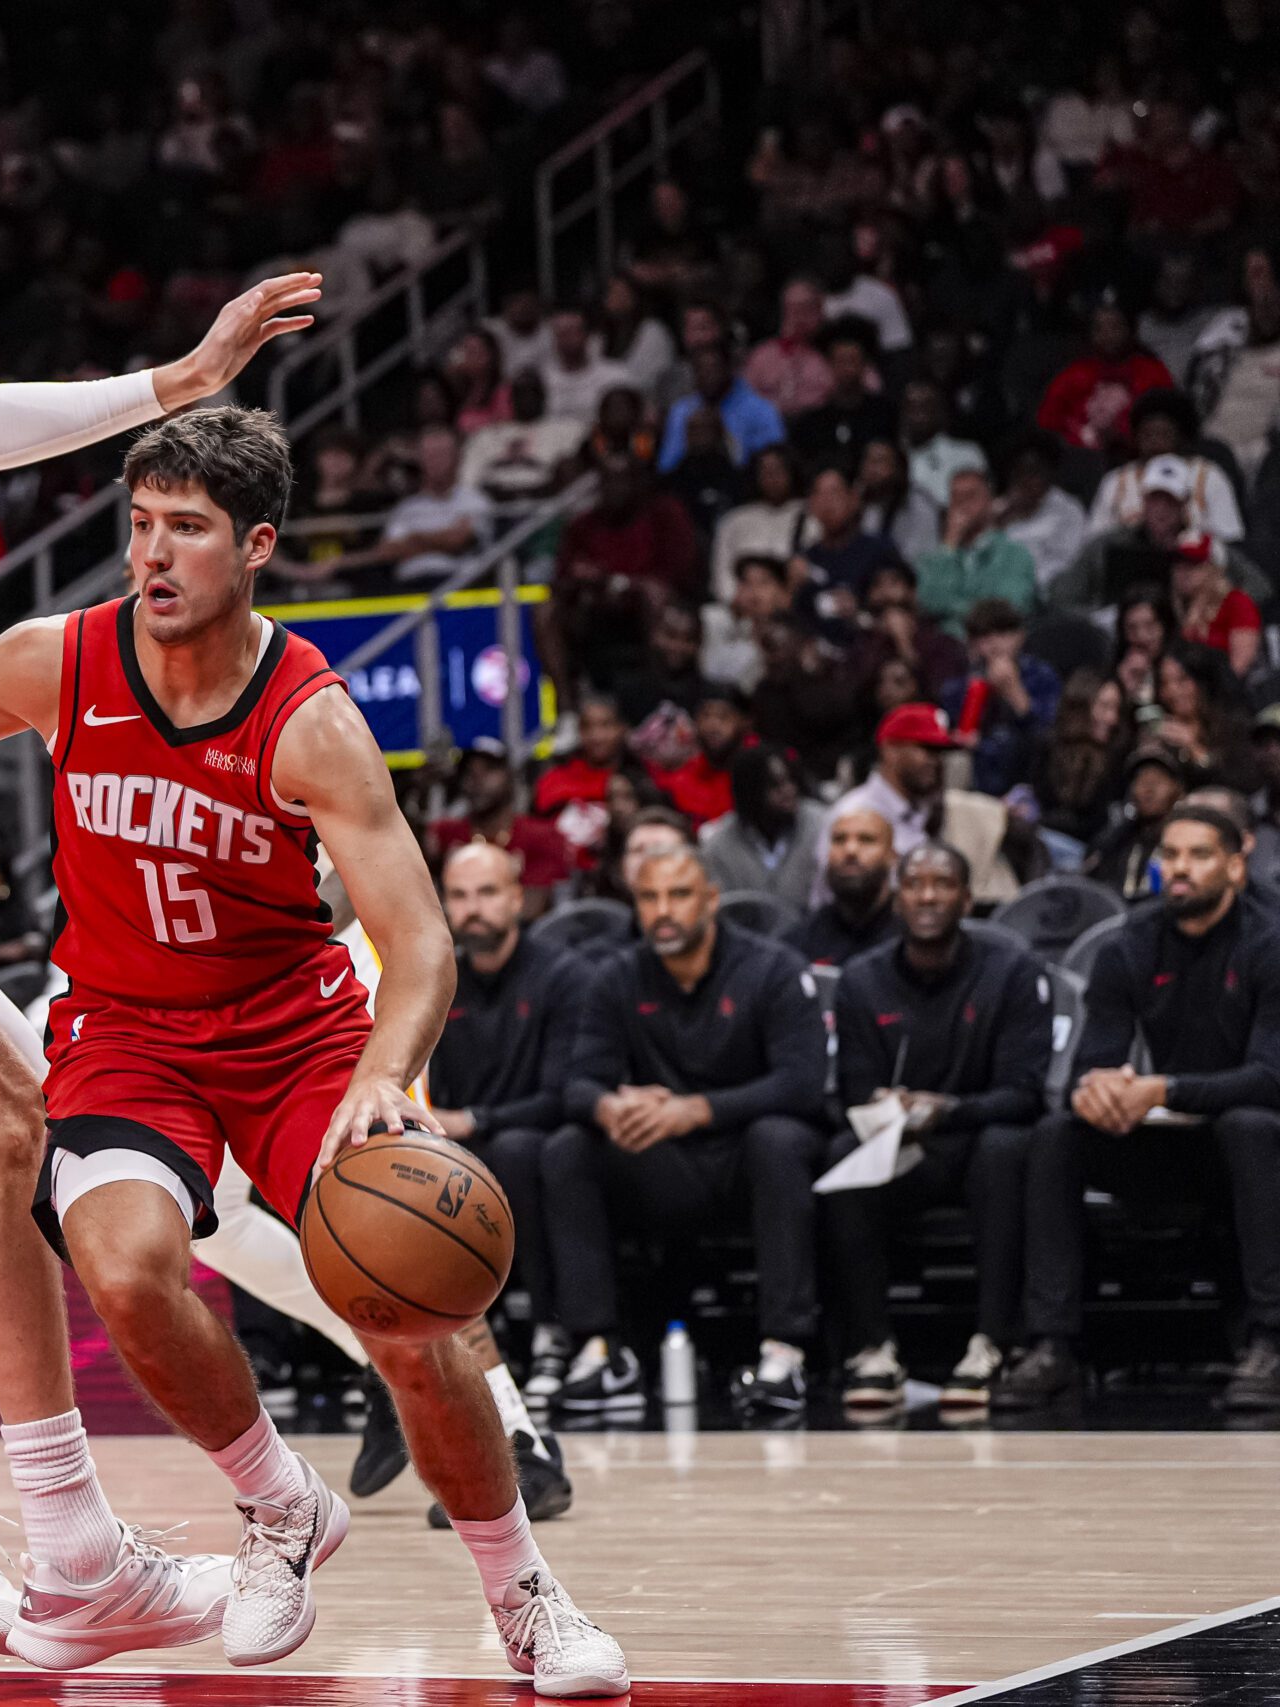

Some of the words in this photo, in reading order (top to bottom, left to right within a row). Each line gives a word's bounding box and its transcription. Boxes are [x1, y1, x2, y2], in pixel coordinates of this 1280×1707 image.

[204, 755, 256, 777] HERMANN
[206, 747, 256, 768] MEMORIAL
[67, 773, 275, 864] ROCKETS
[135, 858, 217, 943] 15
